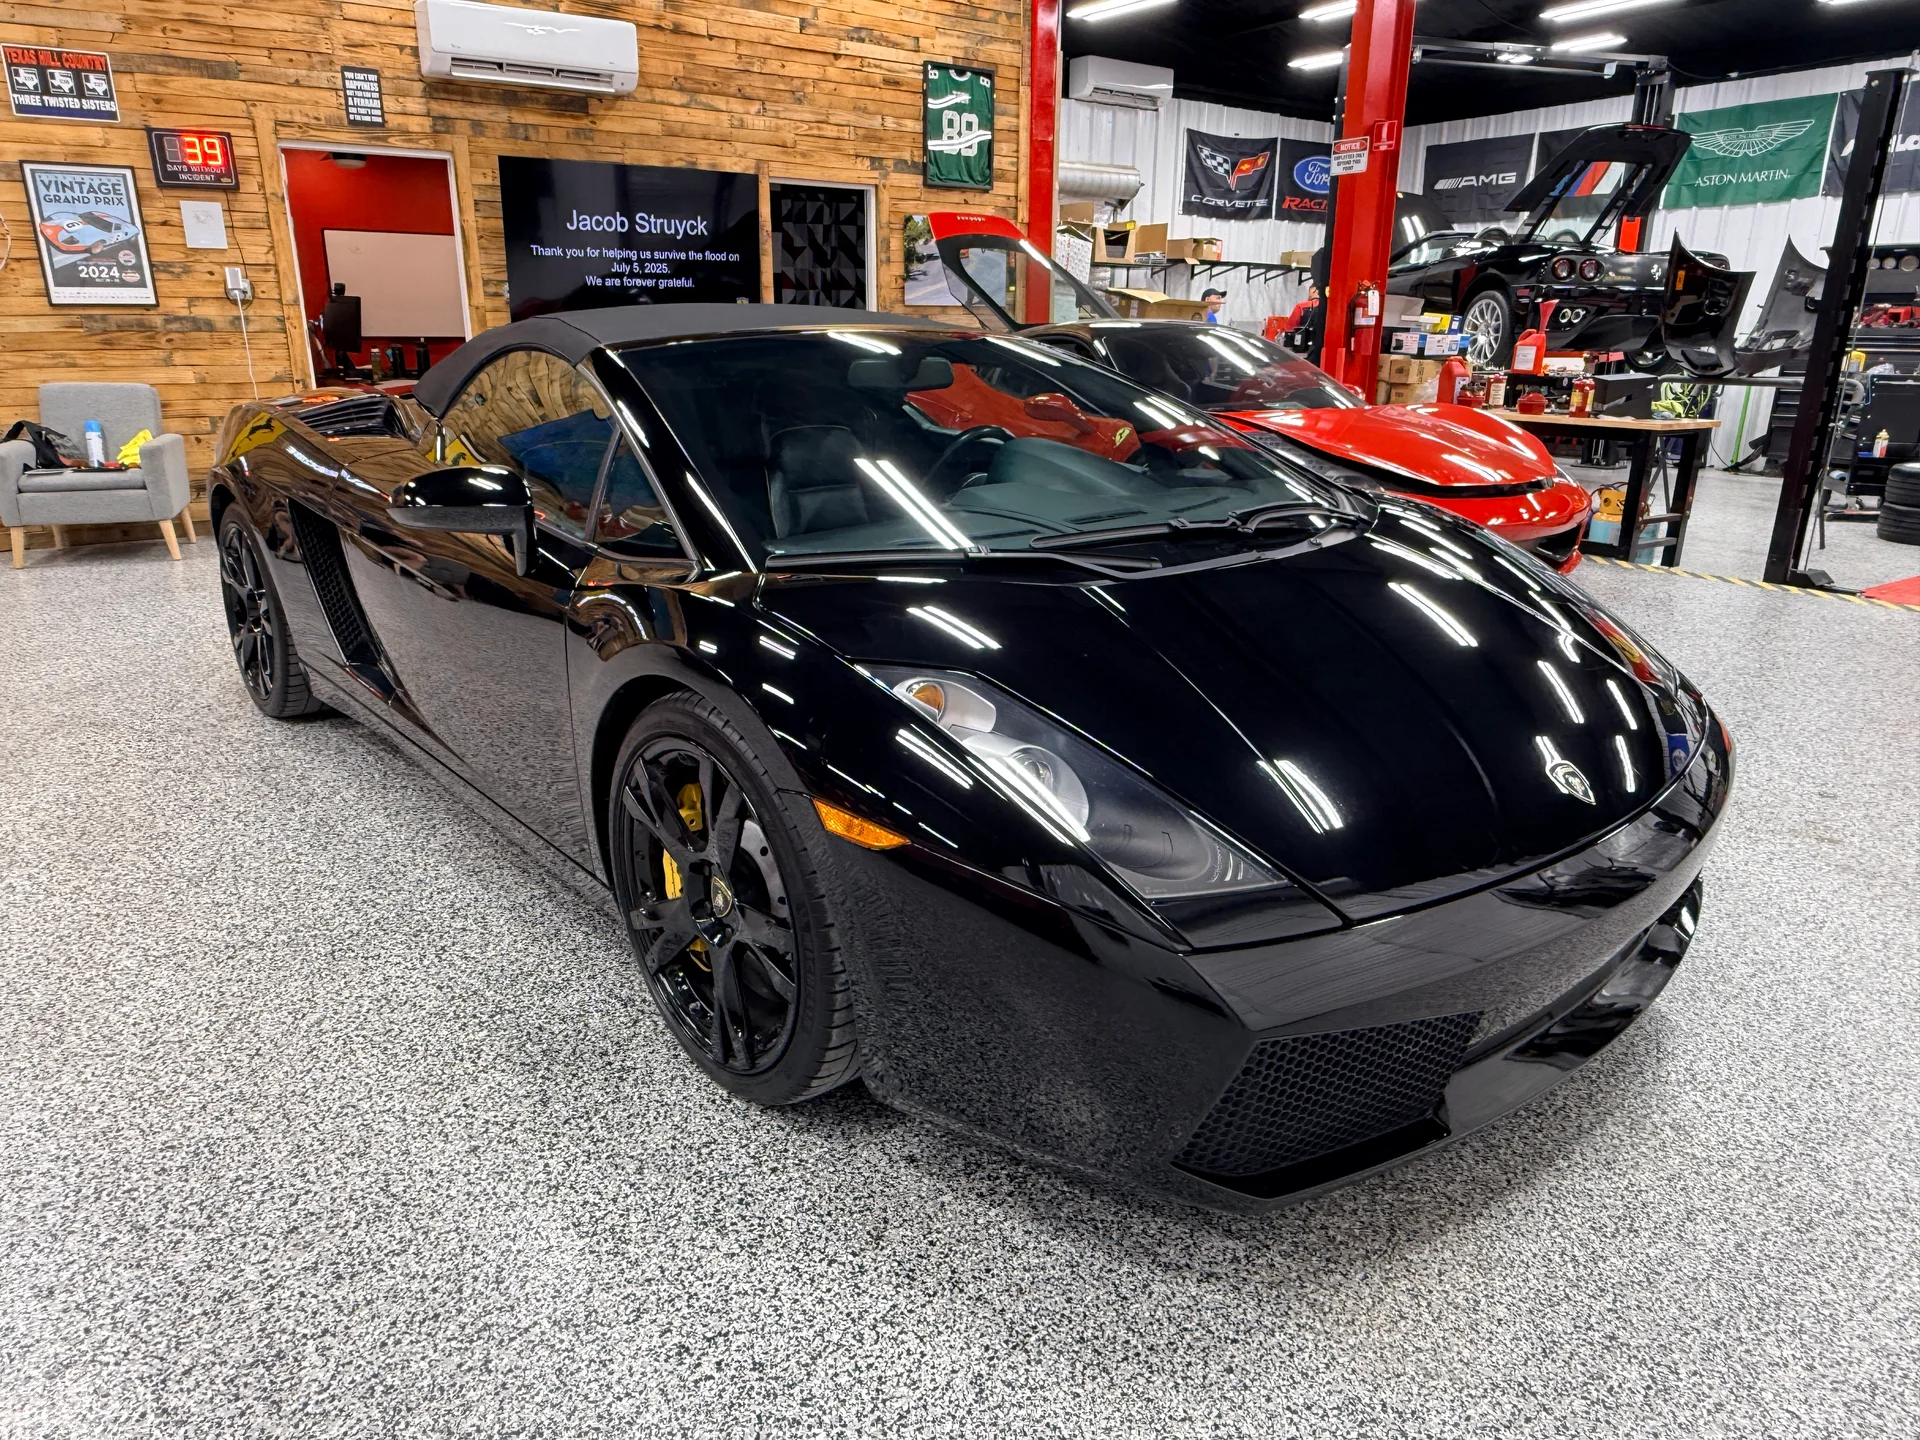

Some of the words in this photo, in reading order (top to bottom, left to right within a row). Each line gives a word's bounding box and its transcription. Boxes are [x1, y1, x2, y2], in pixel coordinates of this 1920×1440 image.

[4, 48, 37, 64] TEXAS
[37, 50, 61, 68] HILL
[62, 53, 106, 70] COUNTRY
[12, 94, 42, 106] THREE
[42, 96, 80, 108] TWISTED
[82, 99, 116, 111] SISTERS
[183, 137, 222, 165] 39
[1340, 142, 1360, 151] NOTICE
[190, 166, 226, 174] WITHOUT
[1304, 161, 1331, 186] For
[1694, 174, 1737, 186] ASTON
[1738, 168, 1789, 183] MARTIN
[40, 180, 123, 196] VINTAGE
[43, 194, 90, 204] GRAND
[94, 196, 124, 206] PRIX
[1192, 194, 1268, 208] CORVETTE
[1282, 196, 1328, 210] RACI
[566, 209, 629, 232] Jacob
[635, 213, 708, 240] Struyck
[530, 244, 564, 256] Thank
[565, 248, 584, 258] you
[586, 247, 600, 257] for
[602, 248, 637, 260] helping
[640, 251, 651, 259] us
[654, 250, 686, 260] survive
[688, 251, 702, 260] the
[705, 251, 726, 261] flood
[728, 253, 740, 261] on
[78, 266, 120, 278] 2024
[611, 262, 630, 274] July
[633, 263, 642, 274] 5,
[644, 263, 671, 274] 2025.
[586, 275, 602, 286] We
[605, 278, 621, 286] are
[623, 276, 656, 287] forever
[658, 277, 695, 289] grateful.
